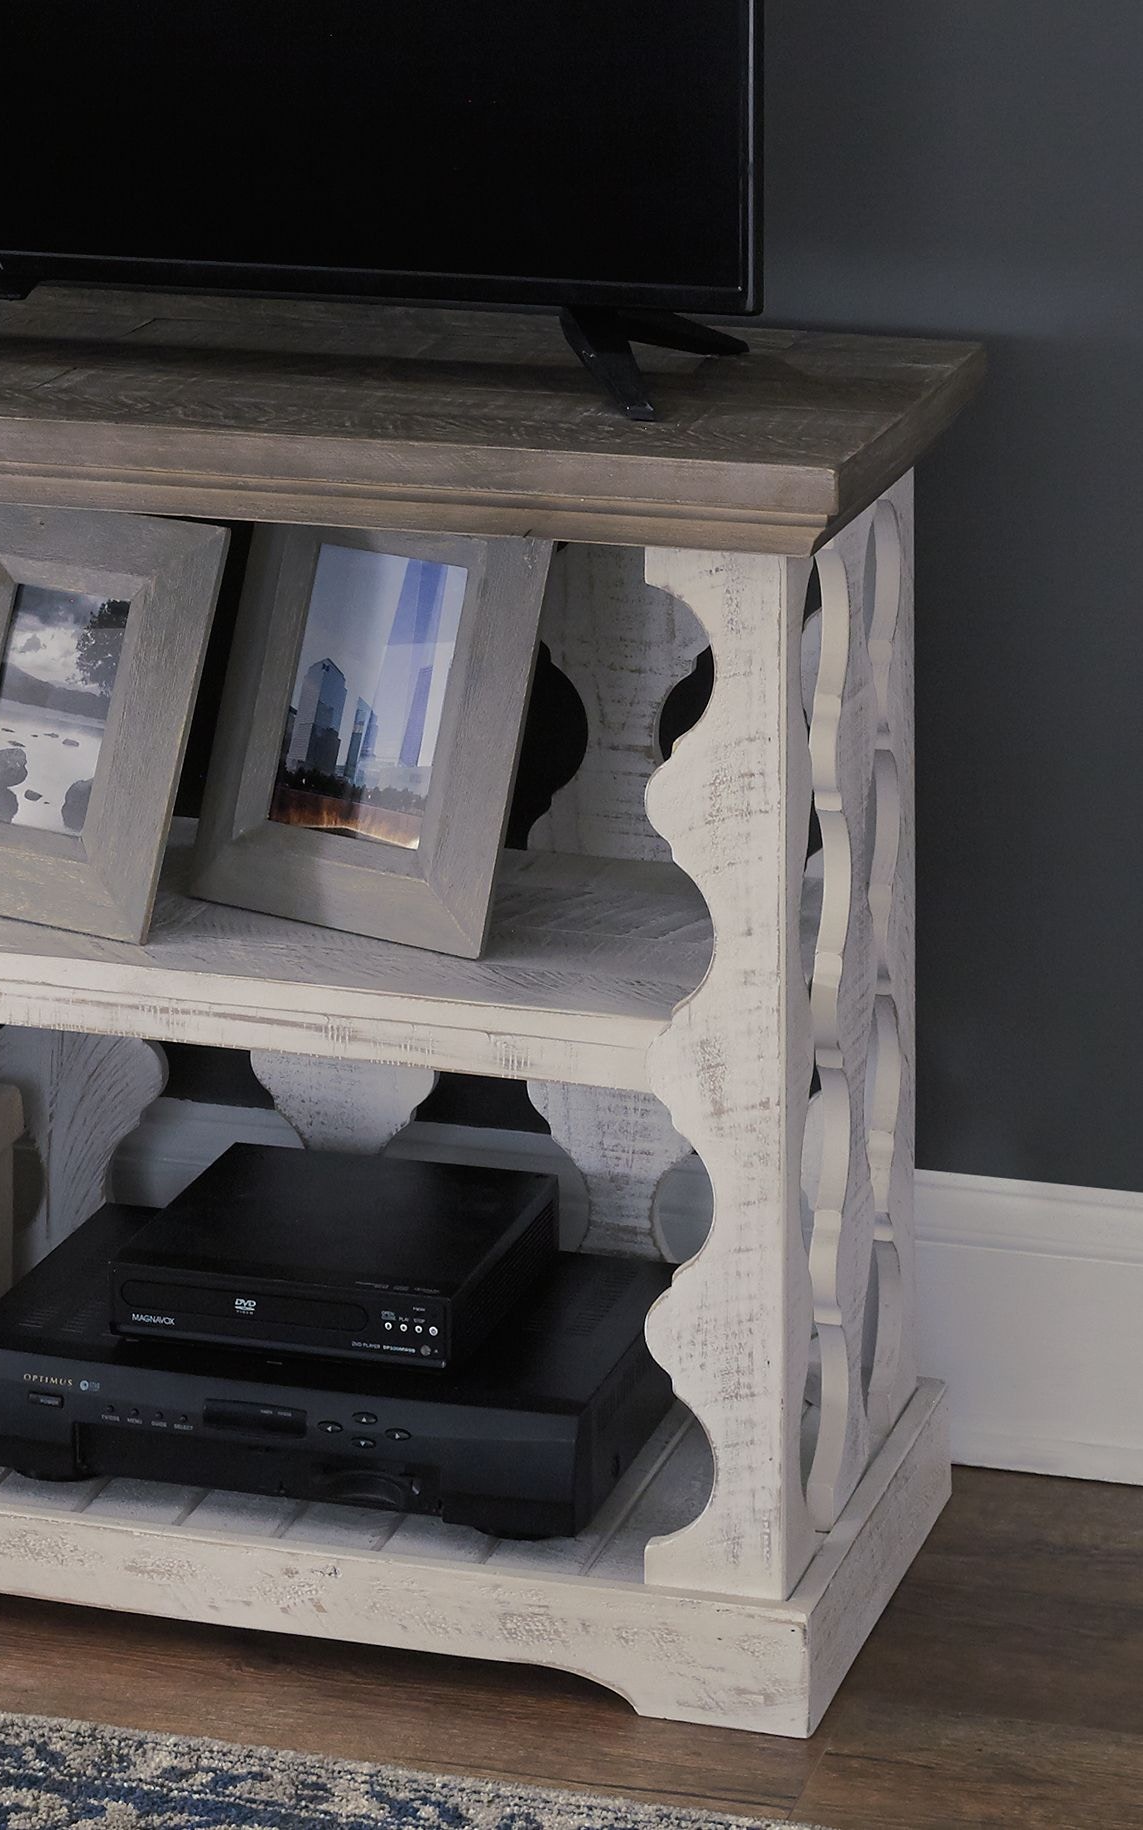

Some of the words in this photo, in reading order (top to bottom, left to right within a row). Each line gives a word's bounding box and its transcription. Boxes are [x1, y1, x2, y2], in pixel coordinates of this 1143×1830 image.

[235, 1298, 256, 1308] DVD
[132, 1313, 175, 1325] MAGNAVOX
[23, 1373, 73, 1386] OPTIMUS
